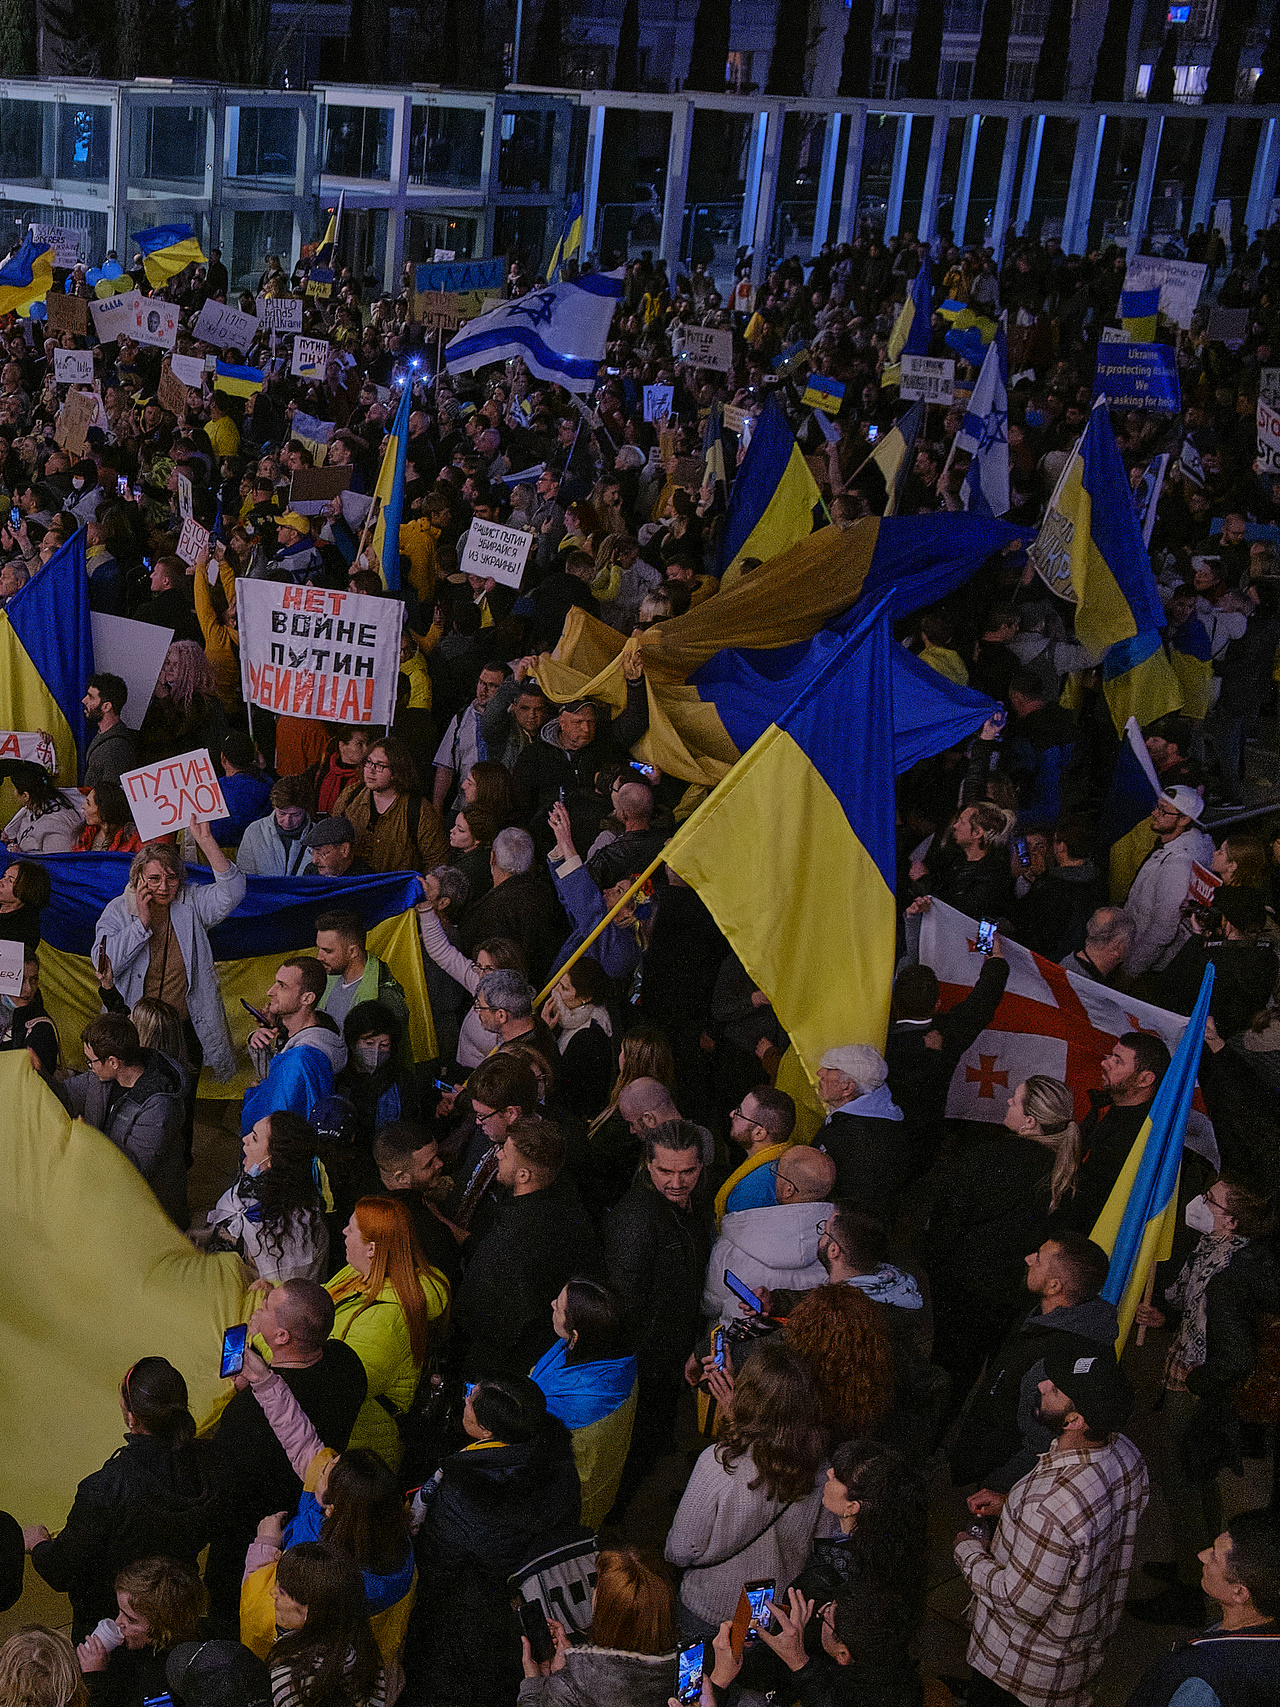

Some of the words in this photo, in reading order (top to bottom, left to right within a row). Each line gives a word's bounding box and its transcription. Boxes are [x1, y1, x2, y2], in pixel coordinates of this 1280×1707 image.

[300, 339, 327, 352] ПУТИН
[1106, 364, 1152, 378] protecting
[1135, 379, 1149, 391] We
[1113, 394, 1144, 408] asking
[1144, 394, 1157, 406] for
[472, 522, 500, 538] ФАШИСТ
[500, 531, 527, 547] ПУТИН
[478, 538, 518, 557] УБИРАЙСЯ
[468, 550, 478, 563] ИЗ
[480, 554, 522, 575] УКРАИНЫ!
[282, 586, 347, 616] НЕТ
[271, 610, 378, 647] ВОЙНЕ
[270, 642, 375, 678] ПУТИН
[248, 660, 375, 722] УБИЙЦА!
[127, 757, 213, 802] ПУТИН
[154, 782, 224, 825] ЗЛО!
